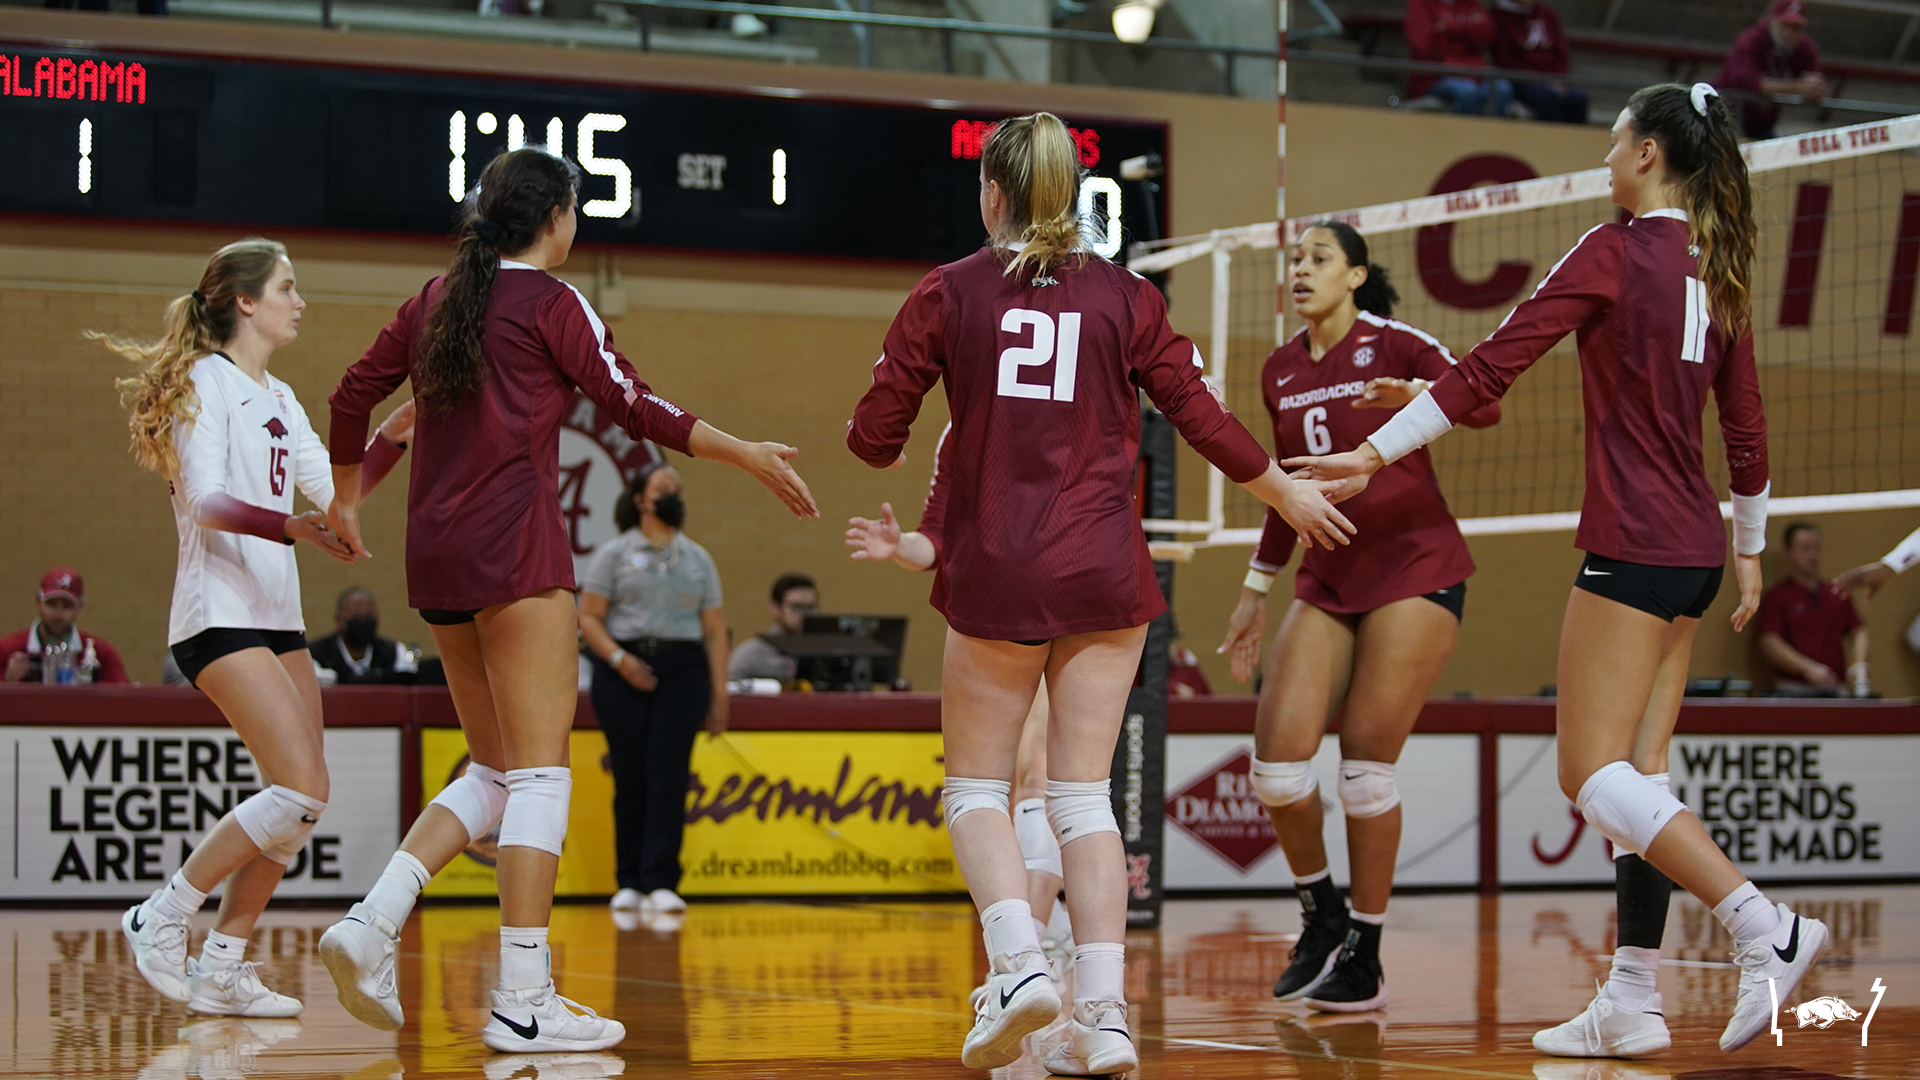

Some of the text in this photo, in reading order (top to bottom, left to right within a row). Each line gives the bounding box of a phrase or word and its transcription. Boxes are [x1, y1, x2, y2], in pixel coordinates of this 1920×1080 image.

[0, 54, 147, 104] ALABAMA
[78, 117, 93, 193] 1
[677, 148, 787, 206] SET 1
[1079, 176, 1122, 259] 0
[1680, 275, 1711, 364] 11
[997, 308, 1081, 402] 21
[1278, 380, 1365, 411] RAZORBACKS
[1303, 405, 1333, 456] 6
[269, 446, 289, 497] 15
[52, 737, 255, 783] WHERE
[1680, 744, 1822, 781] WHERE
[51, 837, 165, 881] ARE
[1709, 824, 1883, 864] RE MADE
